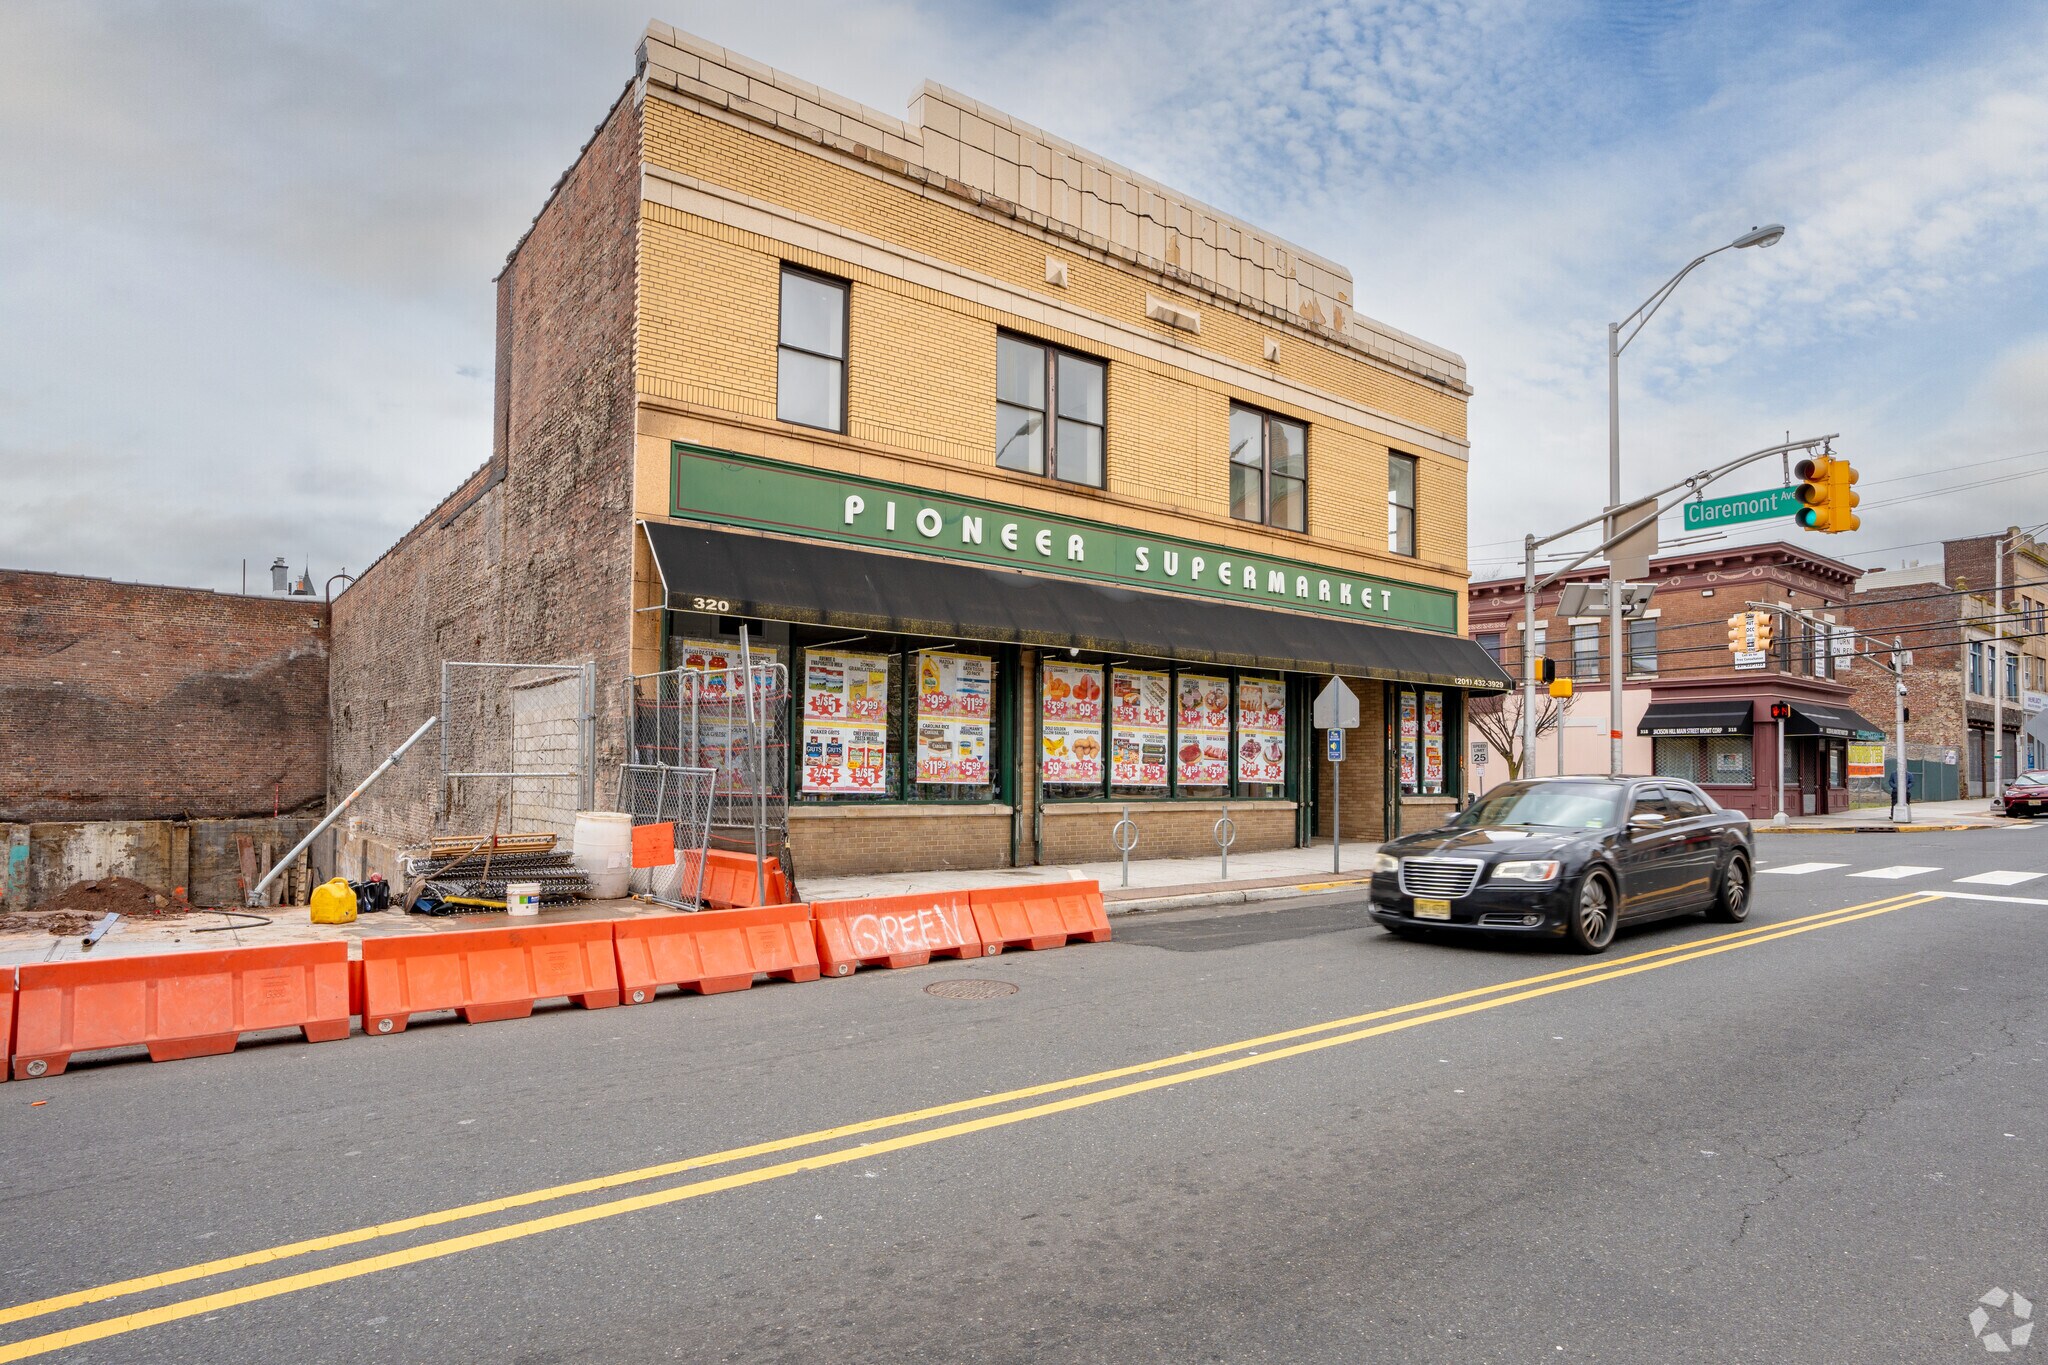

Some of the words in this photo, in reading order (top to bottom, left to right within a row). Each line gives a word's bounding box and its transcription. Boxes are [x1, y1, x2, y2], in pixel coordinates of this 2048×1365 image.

[1688, 493, 1778, 523] Claremont
[1780, 490, 1796, 501] Ave
[843, 494, 1084, 562] PIONEER
[1134, 545, 1391, 612] SUPERMARKET
[693, 597, 730, 612] 320
[1454, 677, 1472, 686] (201)
[1473, 679, 1504, 689] 432-3929
[1473, 753, 1487, 762] 25
[851, 897, 966, 957] GREEN
